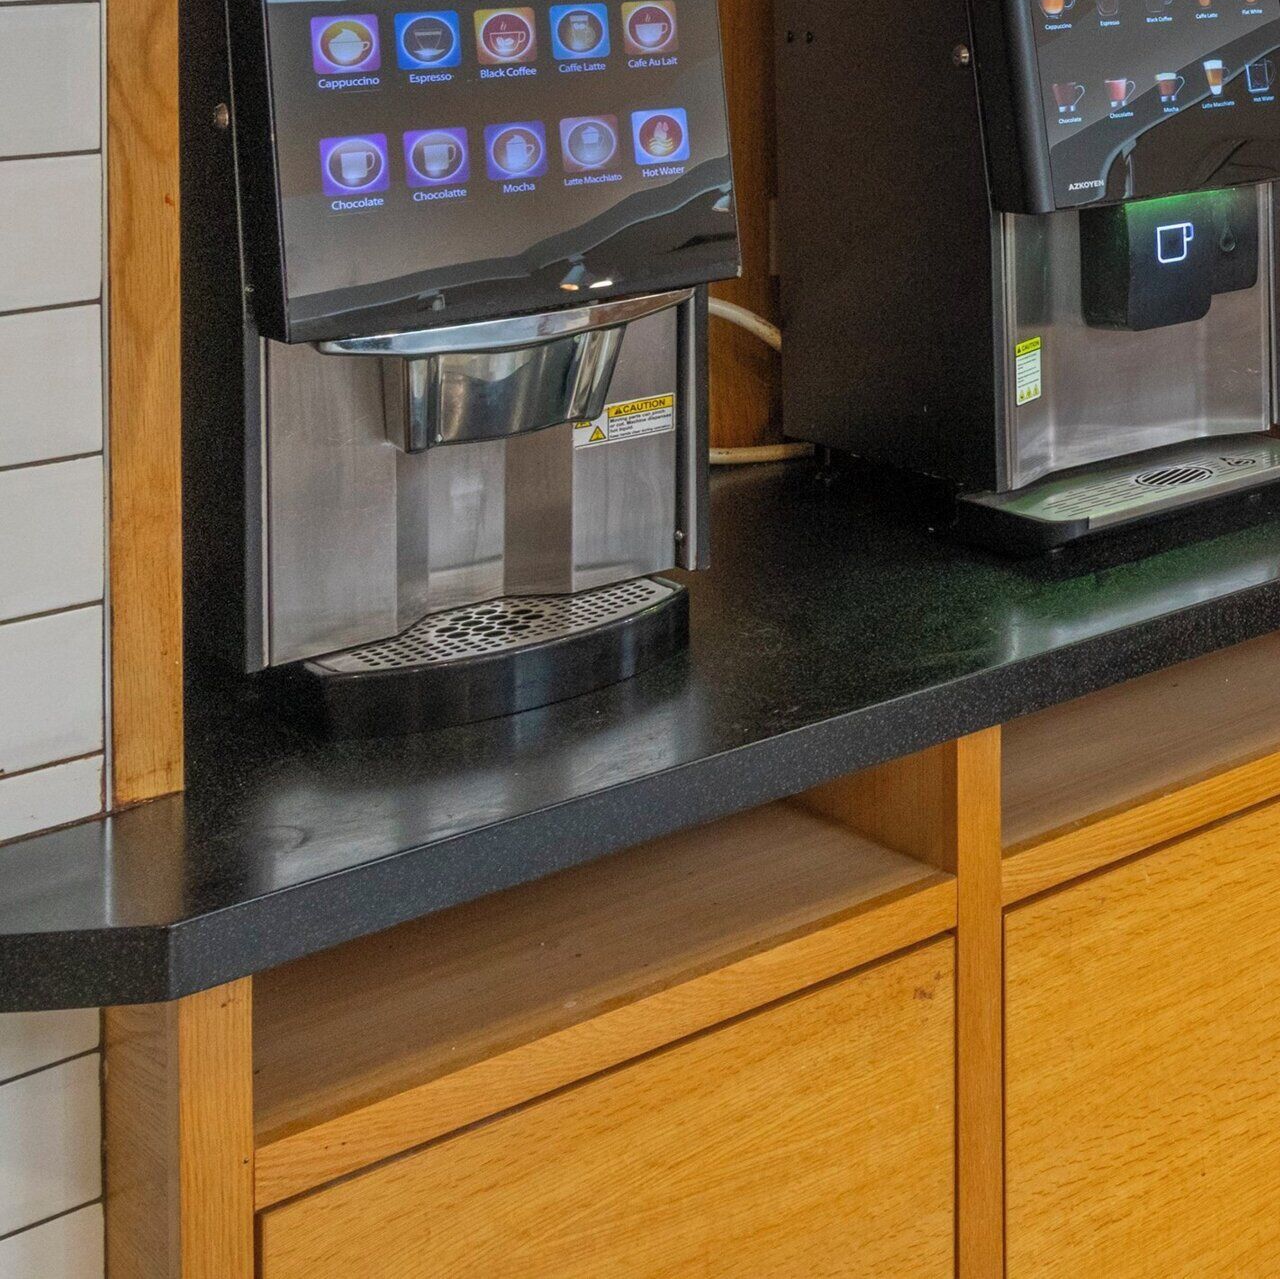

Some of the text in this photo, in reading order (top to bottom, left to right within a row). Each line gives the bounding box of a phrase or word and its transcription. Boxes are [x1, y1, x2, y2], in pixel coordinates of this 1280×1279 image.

[559, 62, 606, 73] Caffe Latte
[628, 57, 678, 68] Cafe Au Lait
[409, 74, 452, 84] Espresso
[480, 67, 537, 79] Black Coffee
[318, 77, 380, 89] Cappuccino
[642, 165, 685, 177] Hot Water
[564, 173, 622, 186] Latte Macchiato
[1068, 180, 1104, 191] AZKOYEN
[503, 182, 535, 193] Mocha
[413, 188, 467, 202] Chocolatte
[331, 197, 384, 211] Chocolate
[623, 399, 666, 413] CAUTION
